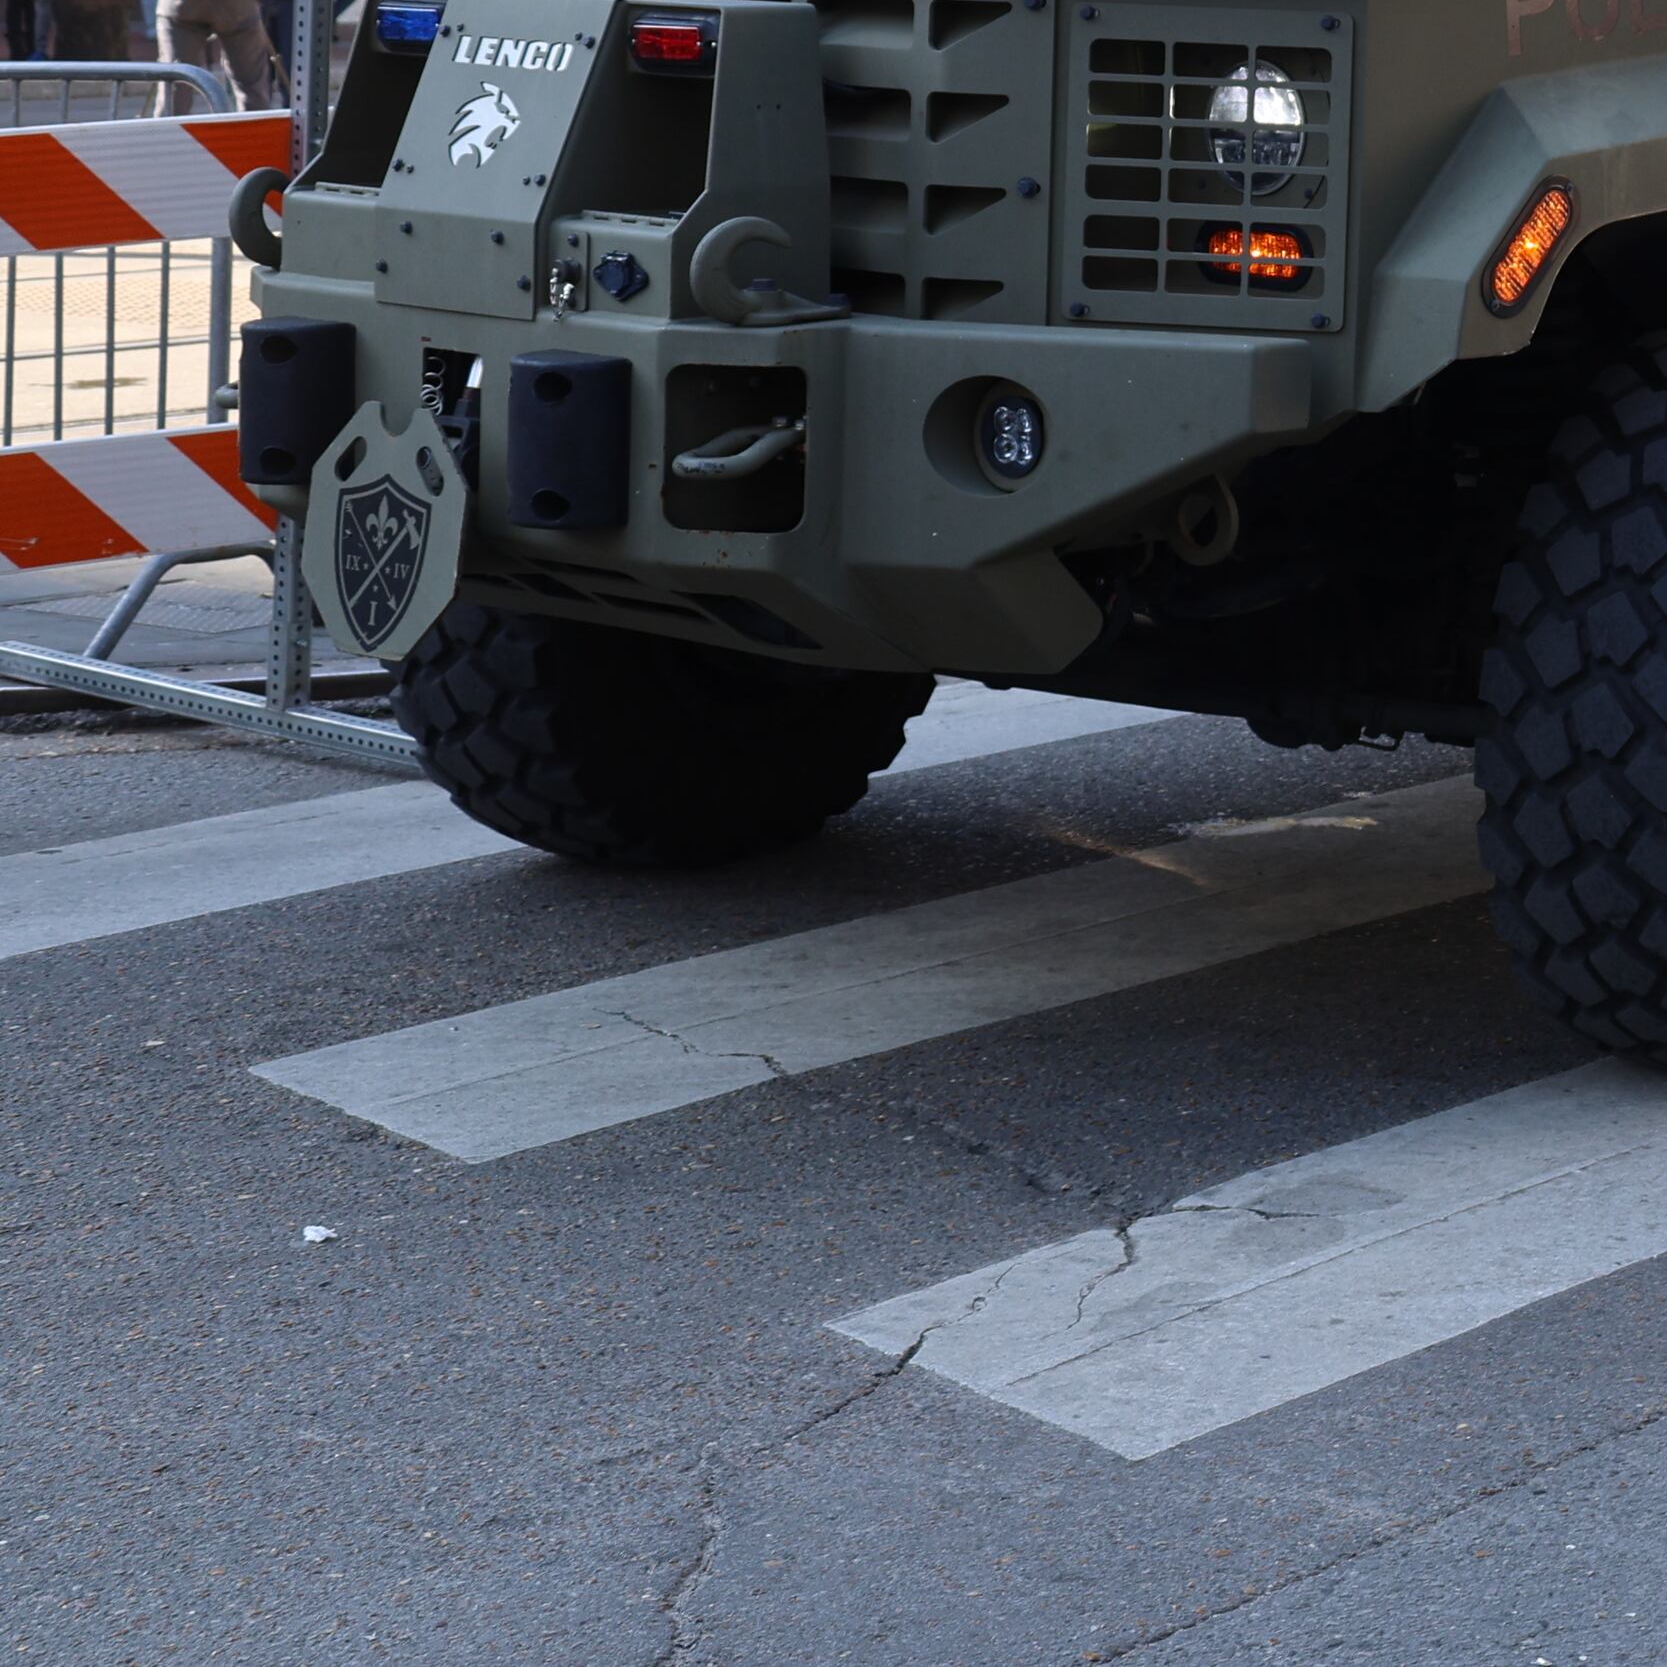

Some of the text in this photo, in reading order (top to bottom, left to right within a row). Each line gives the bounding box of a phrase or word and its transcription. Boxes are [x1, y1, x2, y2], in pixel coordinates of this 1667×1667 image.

[452, 34, 574, 72] LENCO
[344, 554, 410, 580] IX IV
